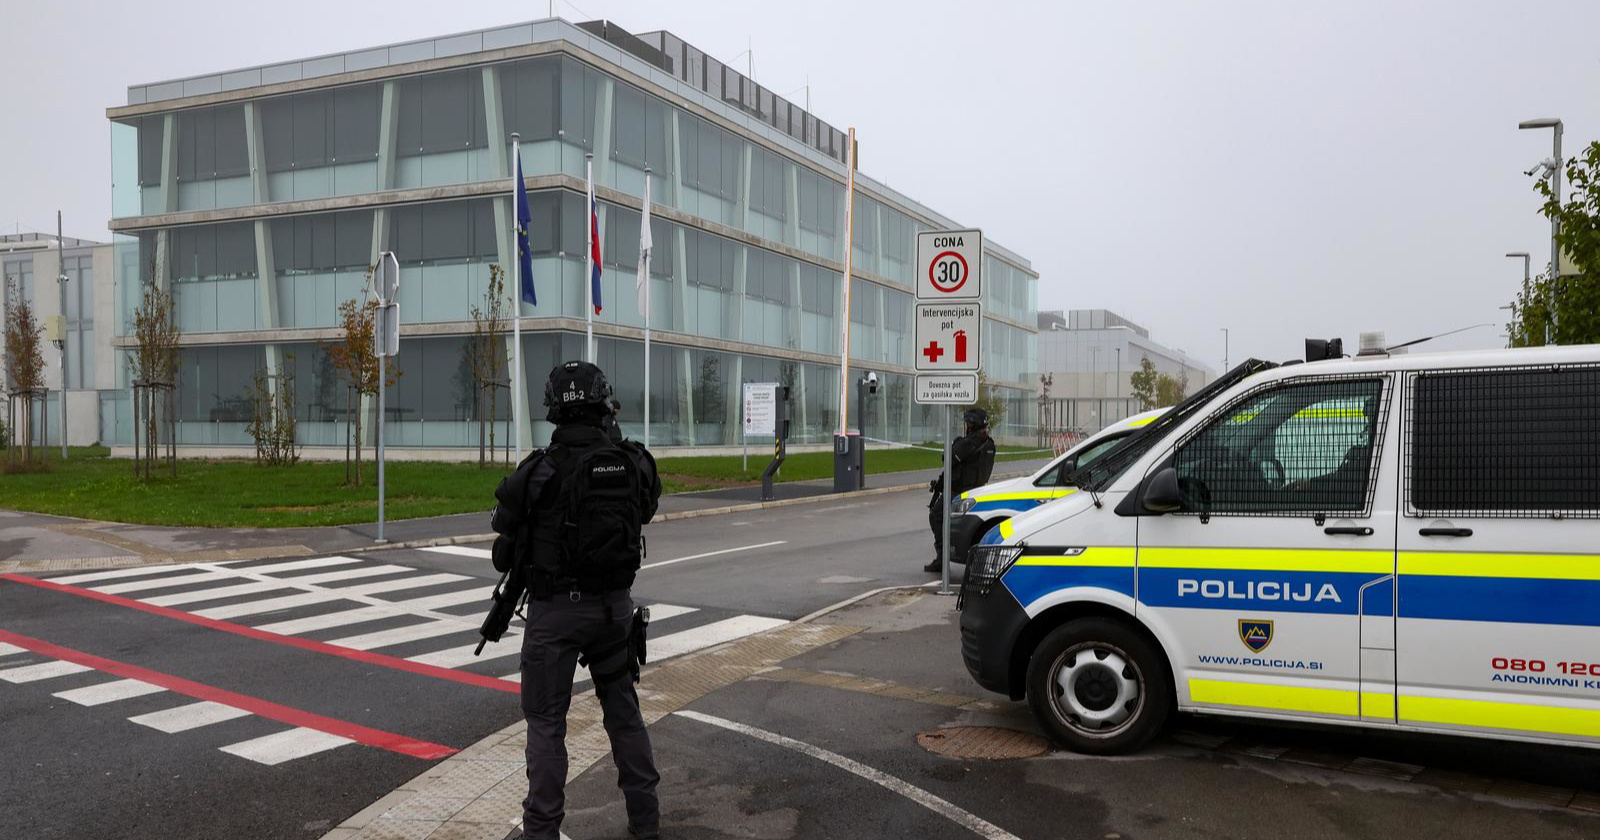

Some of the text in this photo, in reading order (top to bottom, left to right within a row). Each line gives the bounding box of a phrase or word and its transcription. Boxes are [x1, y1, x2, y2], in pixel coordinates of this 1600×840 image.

[934, 236, 964, 247] CONA
[937, 261, 960, 283] 30
[922, 308, 974, 319] Intervencijska
[941, 321, 954, 331] pot
[569, 380, 576, 390] 4
[928, 381, 961, 390] Dovozna pot
[562, 390, 585, 403] BB-2
[931, 391, 953, 400] gasilska
[592, 465, 626, 473] POLICIJA
[1177, 579, 1342, 603] POLICIJA
[1198, 655, 1323, 670] WWW.POLICIJA.SI
[1491, 657, 1546, 672] 080
[1492, 673, 1579, 687] ANONIMNI
